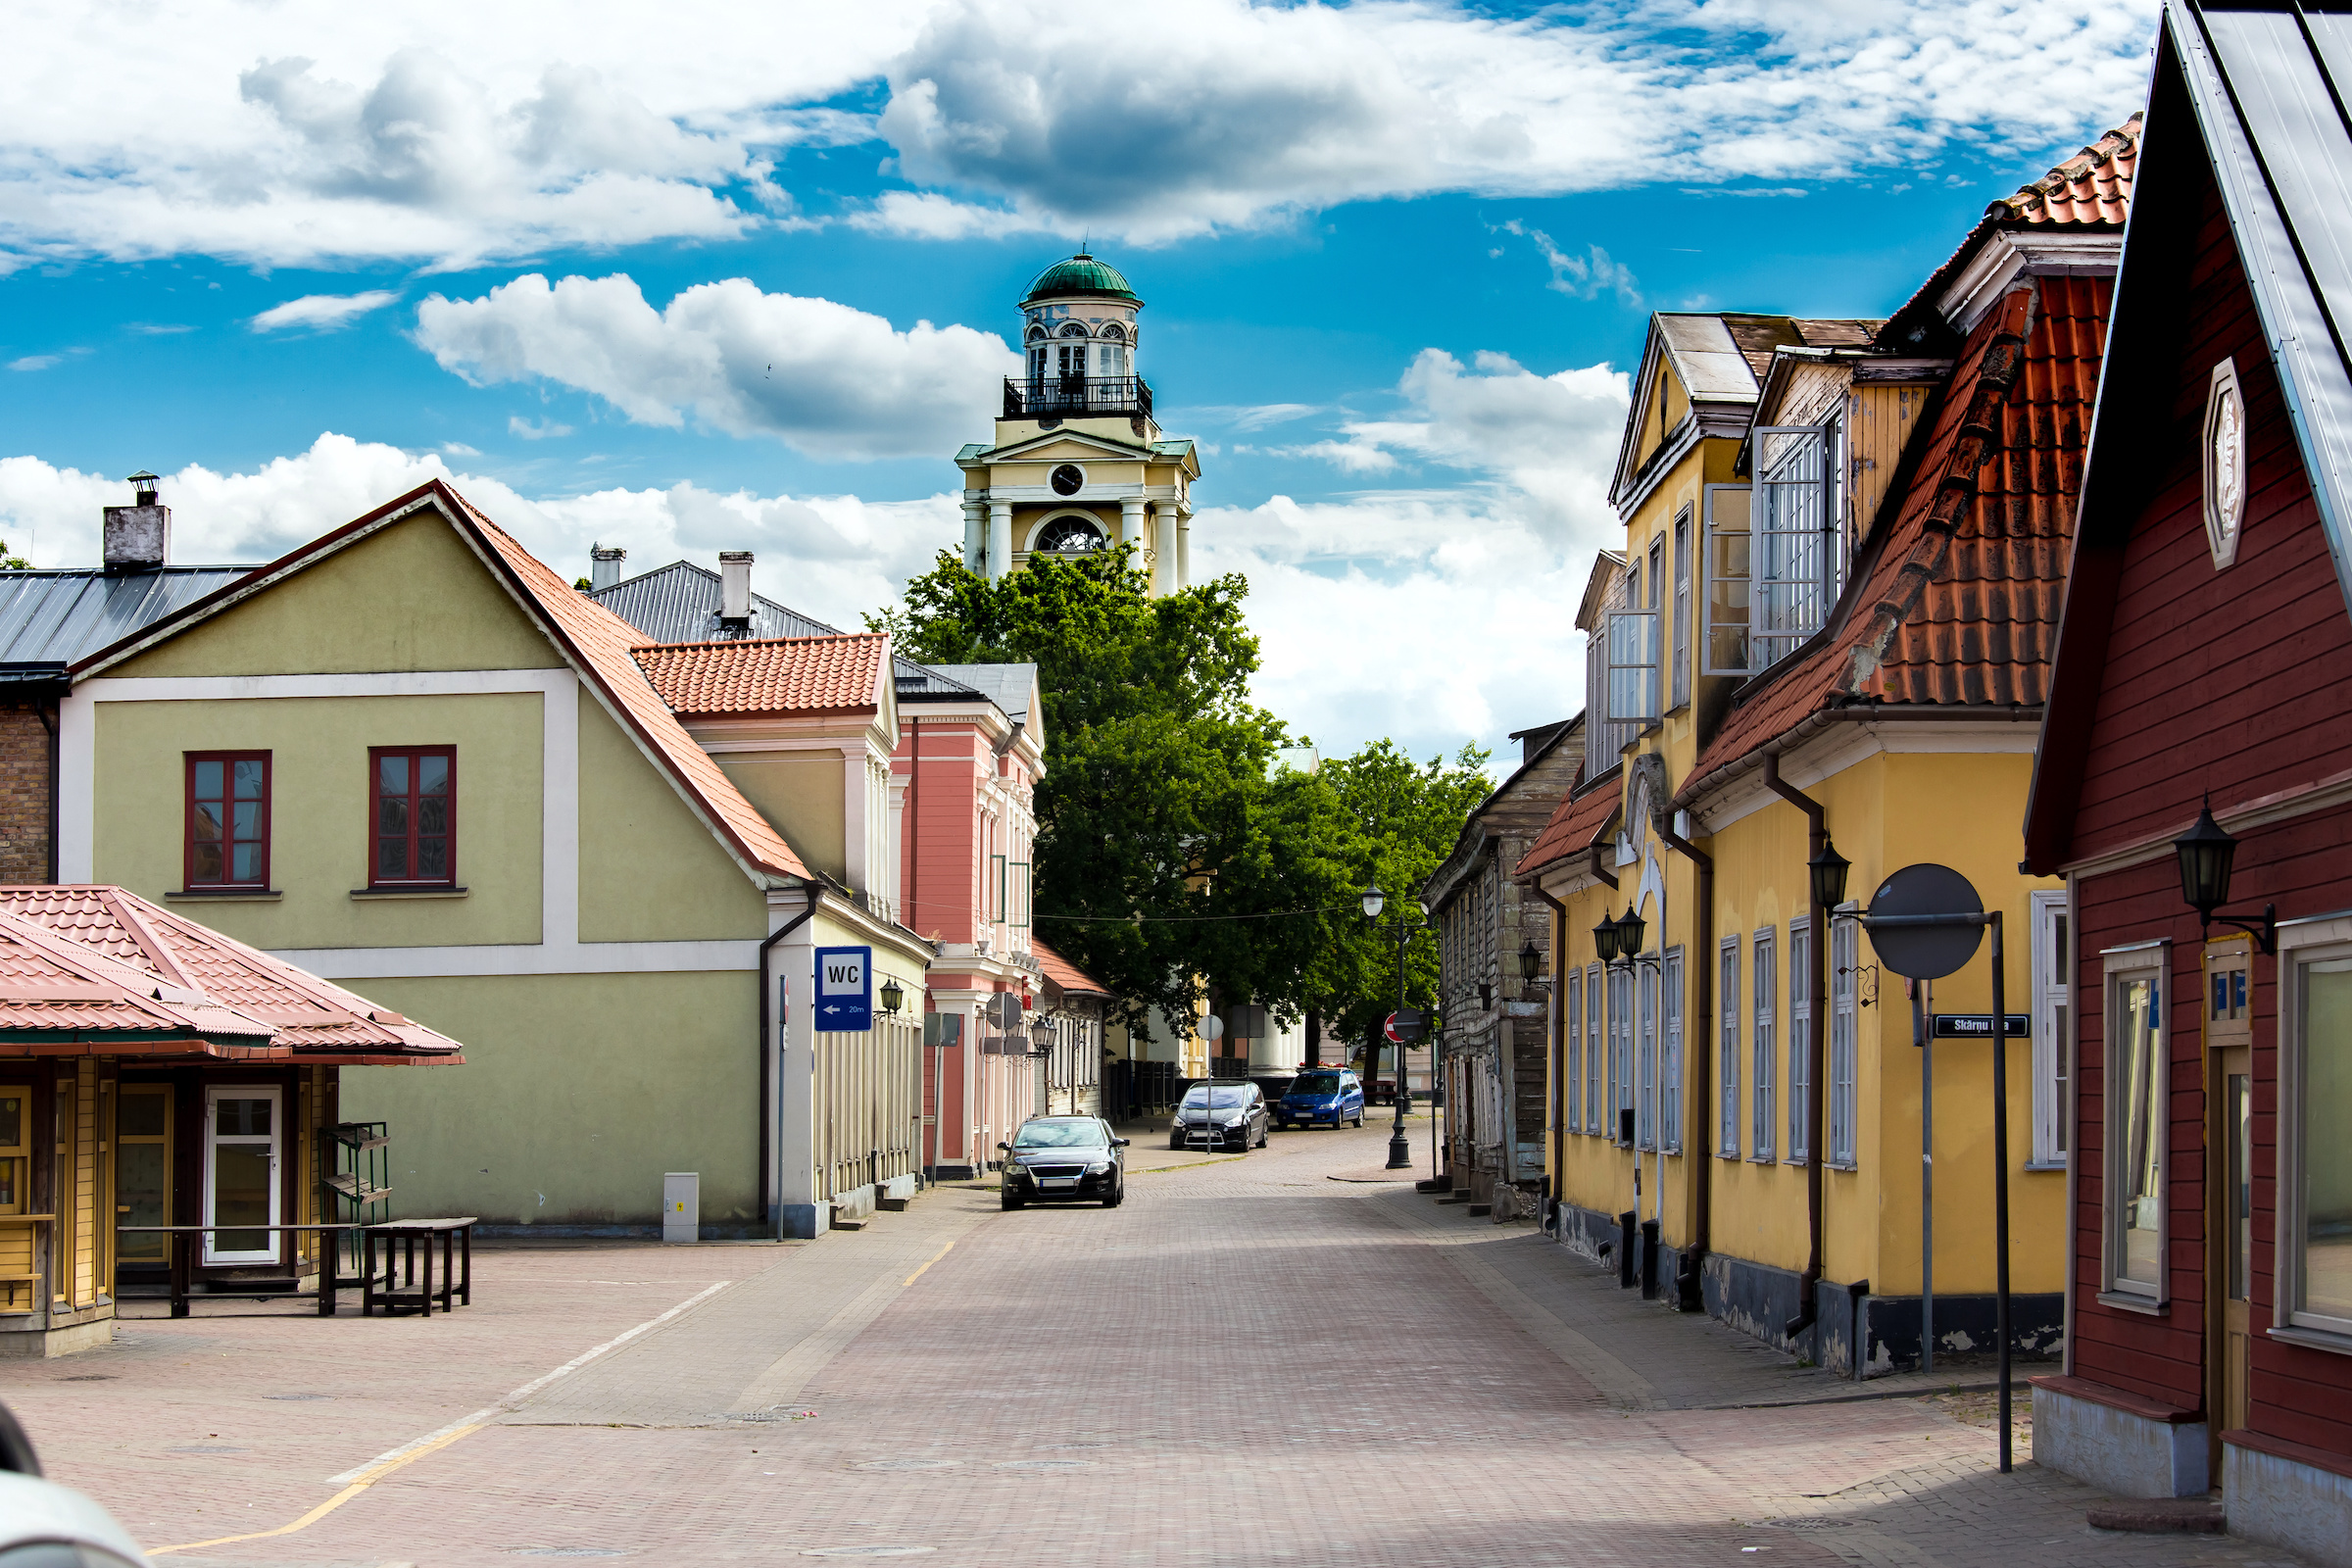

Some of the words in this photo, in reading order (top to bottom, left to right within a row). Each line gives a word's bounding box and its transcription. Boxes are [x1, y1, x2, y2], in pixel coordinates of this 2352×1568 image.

[828, 965, 858, 983] WC
[1954, 1019, 1988, 1033] Skārņu
[1990, 1019, 2009, 1031] ia
